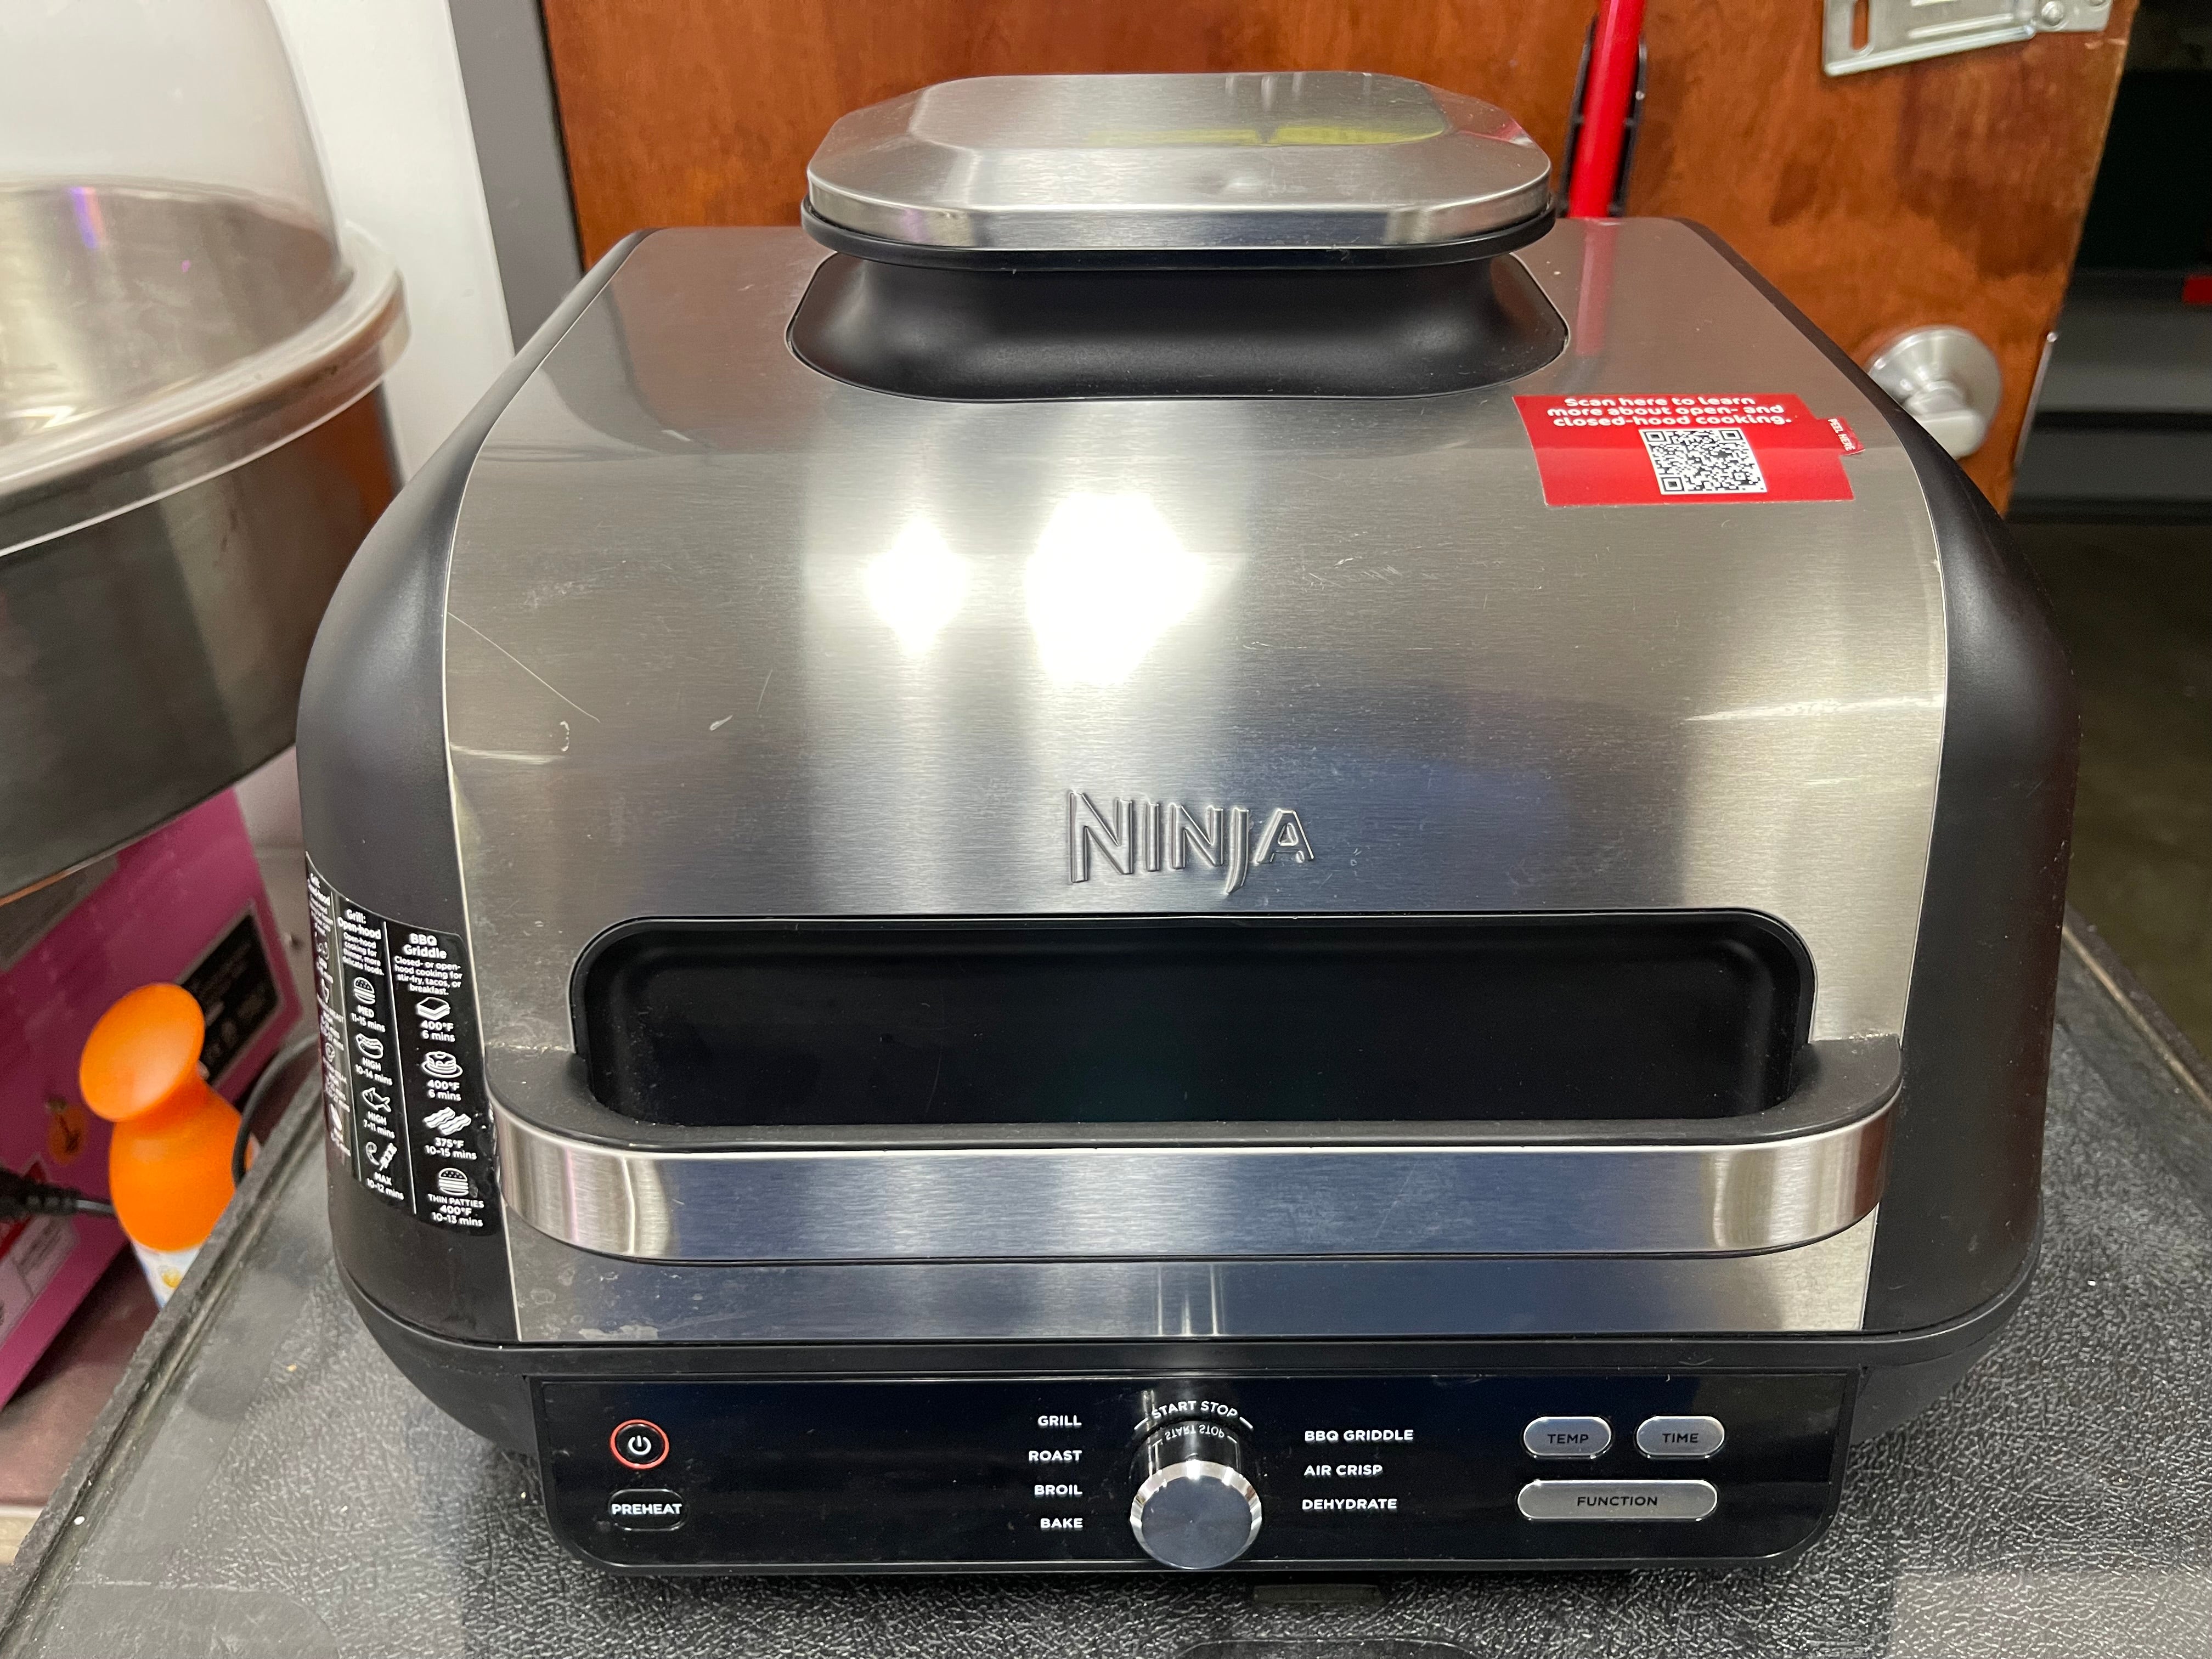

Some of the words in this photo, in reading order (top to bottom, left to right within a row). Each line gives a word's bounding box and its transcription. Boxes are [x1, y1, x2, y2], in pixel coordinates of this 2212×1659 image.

[1564, 398, 1616, 407] Scan
[1618, 397, 1668, 406] here
[1671, 397, 1695, 405] to
[1697, 396, 1756, 405] learn
[1547, 408, 1603, 416] more
[1607, 407, 1672, 415] about
[1675, 407, 1739, 416] open-
[1743, 404, 1784, 414] and
[1553, 415, 1691, 427] closed-hood
[1695, 414, 1792, 425] cooking.
[1827, 419, 1843, 433] PEEL
[1838, 434, 1855, 451] HERE
[1069, 789, 1315, 894] NINJA
[346, 909, 366, 924] Grill:
[337, 917, 381, 939] Open-hood
[409, 933, 437, 946] BBQ
[367, 948, 377, 957] for
[402, 944, 447, 959] Griddle
[364, 957, 381, 967] more
[394, 955, 423, 967] Closed-
[436, 962, 461, 970] open-
[364, 963, 385, 975] foods.
[394, 964, 414, 974] hood
[416, 969, 448, 979] cooking
[449, 970, 462, 979] for
[397, 973, 424, 985] stir-fry,
[425, 978, 450, 988] tacos,
[409, 983, 449, 995] breakfast.
[358, 1005, 375, 1018] MED
[351, 1013, 366, 1026] 11-15
[367, 1020, 386, 1033] mins
[420, 1020, 454, 1031] 400°F
[421, 1030, 430, 1039] 6
[431, 1031, 456, 1042] mins
[362, 1057, 381, 1071] HIGH
[355, 1064, 373, 1079] 10-14
[374, 1073, 393, 1086] mins
[426, 1079, 460, 1091] 400°F
[428, 1089, 436, 1098] 6
[438, 1091, 461, 1102] mins
[368, 1111, 387, 1126] HIGH
[363, 1119, 376, 1131] 7-11
[377, 1126, 395, 1139] mins
[434, 1137, 464, 1148] 375°F
[425, 1145, 451, 1158] 10-15
[453, 1149, 477, 1160] mins
[374, 1172, 392, 1186] MAX
[366, 1178, 385, 1193] 10-12
[386, 1187, 404, 1200] mins
[427, 1193, 448, 1204] THIN
[449, 1198, 484, 1209] PATTIES
[439, 1204, 472, 1216] 400°F
[431, 1211, 458, 1223] 10-13
[459, 1216, 483, 1227] mins
[1151, 1400, 1197, 1419] START
[1200, 1401, 1238, 1417] STOP
[1037, 1415, 1082, 1427] GRILL
[1305, 1430, 1339, 1442] BBQ
[1344, 1430, 1414, 1441] GRIDDLE
[1547, 1433, 1589, 1444] TEMP
[1662, 1432, 1699, 1443] TIME
[1029, 1449, 1082, 1462] ROAST
[1304, 1465, 1332, 1476] AIR
[1336, 1464, 1383, 1476] CRISP
[1034, 1484, 1083, 1497] BROIL
[1302, 1498, 1397, 1510] DEHYDRATE
[1577, 1496, 1658, 1506] FUNCTION
[611, 1503, 682, 1515] PREHEAT
[1040, 1517, 1083, 1530] BAKE
